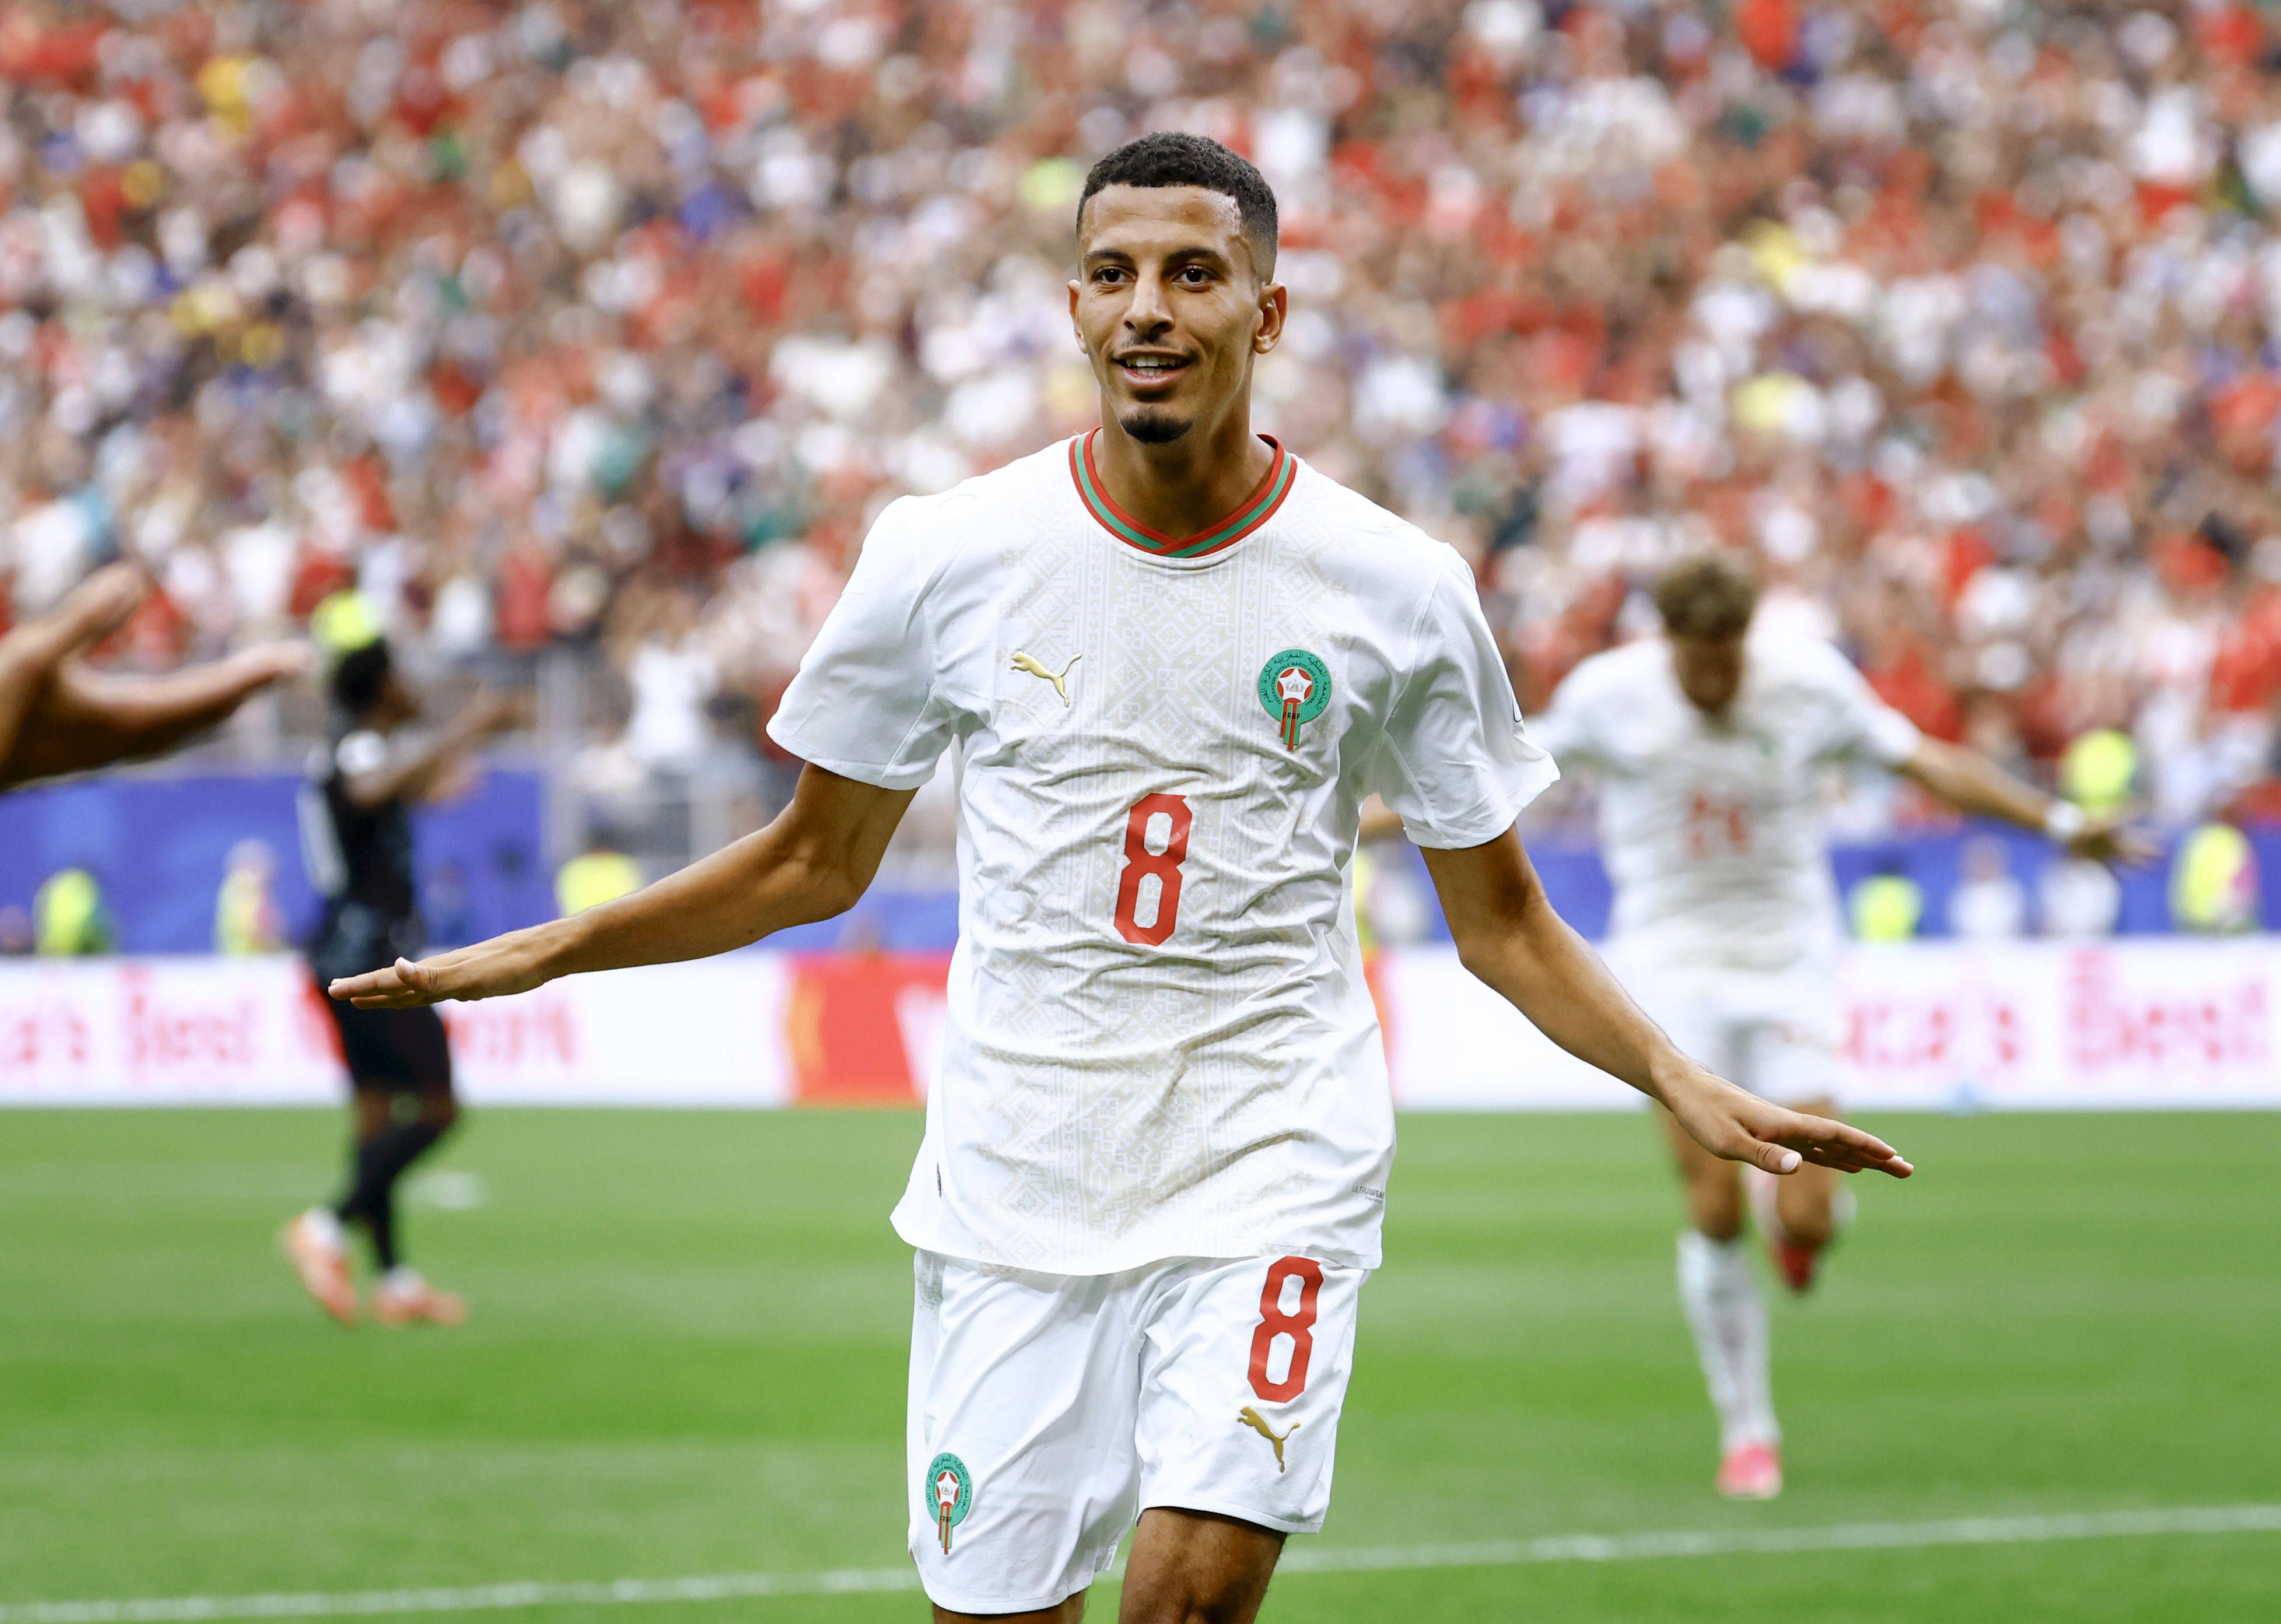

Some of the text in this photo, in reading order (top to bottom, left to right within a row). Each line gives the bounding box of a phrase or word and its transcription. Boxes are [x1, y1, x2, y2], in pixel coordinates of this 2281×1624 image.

[1260, 651, 1330, 710] الجامعة الملكية المغربية لكرة القدم
[1291, 662, 1316, 676] MAROCAINE
[1305, 686, 1319, 706] FOOTBALL
[1113, 793, 1192, 947] 8
[1247, 1255, 1324, 1403] 8
